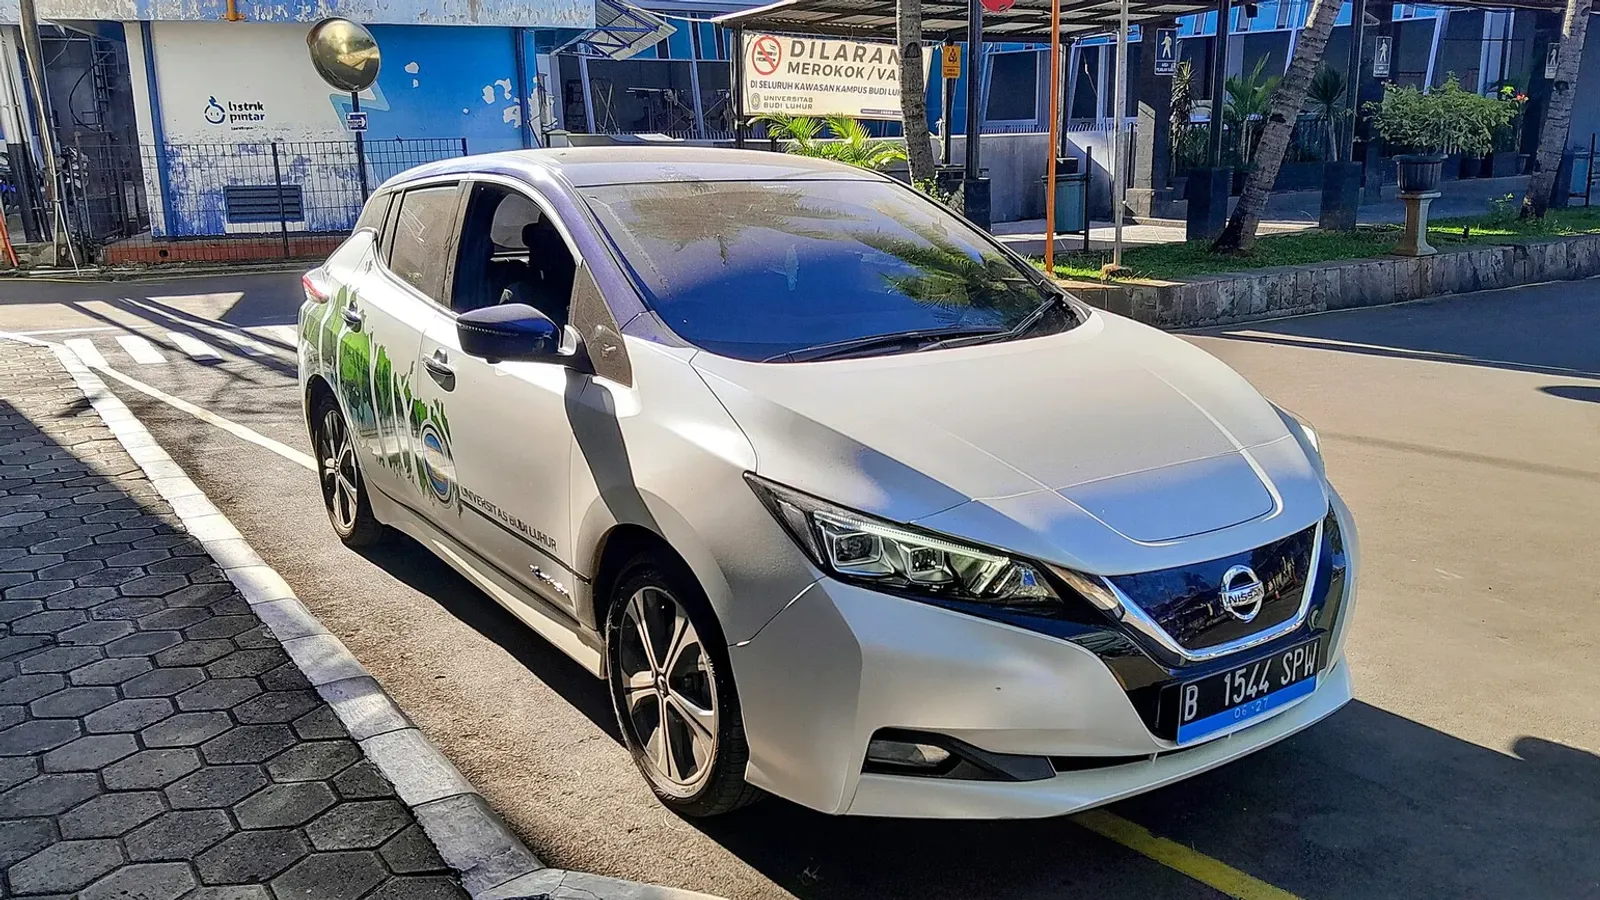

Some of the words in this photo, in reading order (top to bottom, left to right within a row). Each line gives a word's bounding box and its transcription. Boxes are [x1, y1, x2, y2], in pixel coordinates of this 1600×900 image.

[750, 80, 757, 89] DI
[759, 81, 793, 90] SELURUH
[794, 82, 835, 92] KAWASAN
[835, 85, 868, 94] KAMPUS
[868, 87, 887, 95] BUDI
[228, 101, 264, 111] listrik
[763, 95, 813, 103] UNIVERSITAS
[229, 113, 265, 124] pintar
[460, 486, 508, 522] UNIVERSITAS
[508, 516, 529, 535] BUDI
[528, 526, 557, 552] LUHUR
[1229, 588, 1264, 604] NISSAN
[1184, 684, 1198, 722] B
[1223, 659, 1273, 706] 1544
[1280, 642, 1318, 686] SPW
